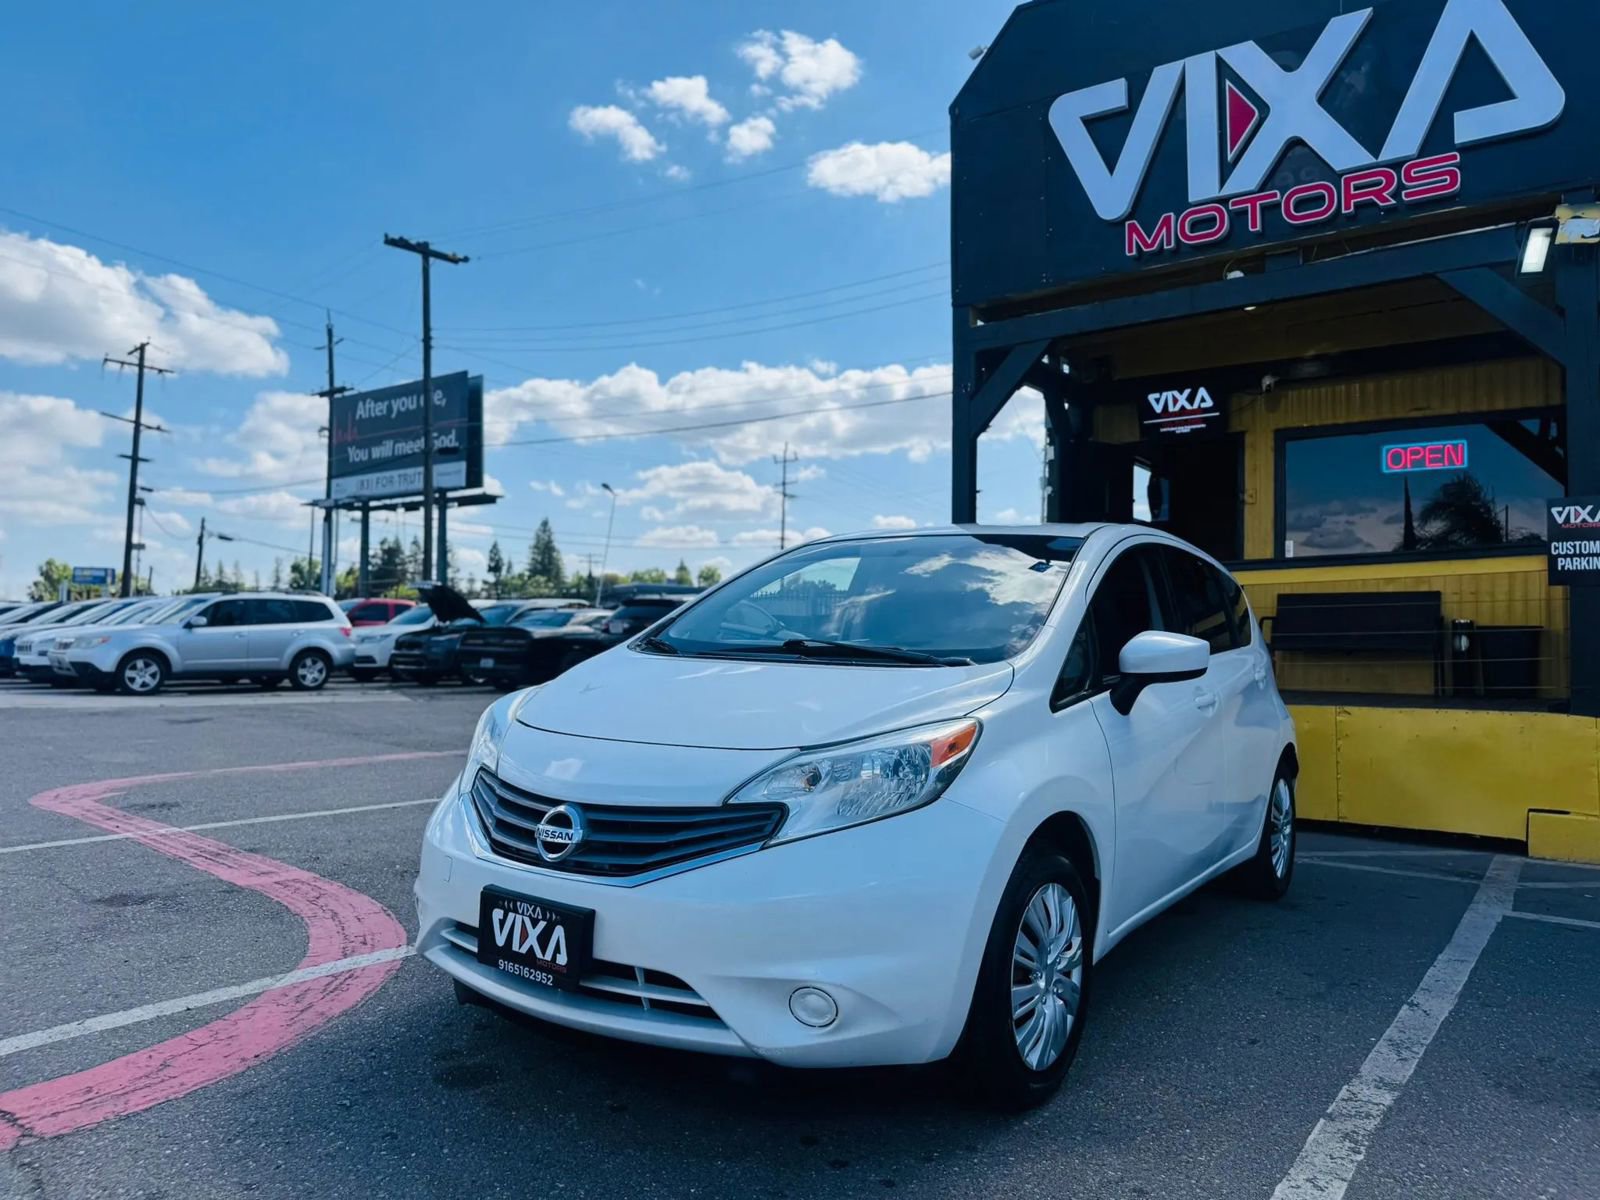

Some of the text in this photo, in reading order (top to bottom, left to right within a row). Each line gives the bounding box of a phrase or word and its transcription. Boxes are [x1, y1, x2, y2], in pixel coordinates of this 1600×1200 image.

[1048, 0, 1566, 221] VIXA
[1124, 151, 1462, 256] MOTORS
[356, 398, 388, 419] After
[391, 394, 416, 418] you
[1147, 386, 1213, 413] VIXA
[347, 445, 369, 463] You
[371, 439, 394, 459] will
[1387, 443, 1464, 470] OPEN
[397, 471, 423, 488] TRUT
[537, 826, 574, 842] NISSAN
[517, 901, 543, 920] VIXA
[492, 907, 568, 966] VIXA
[498, 959, 554, 986] 9165162952
